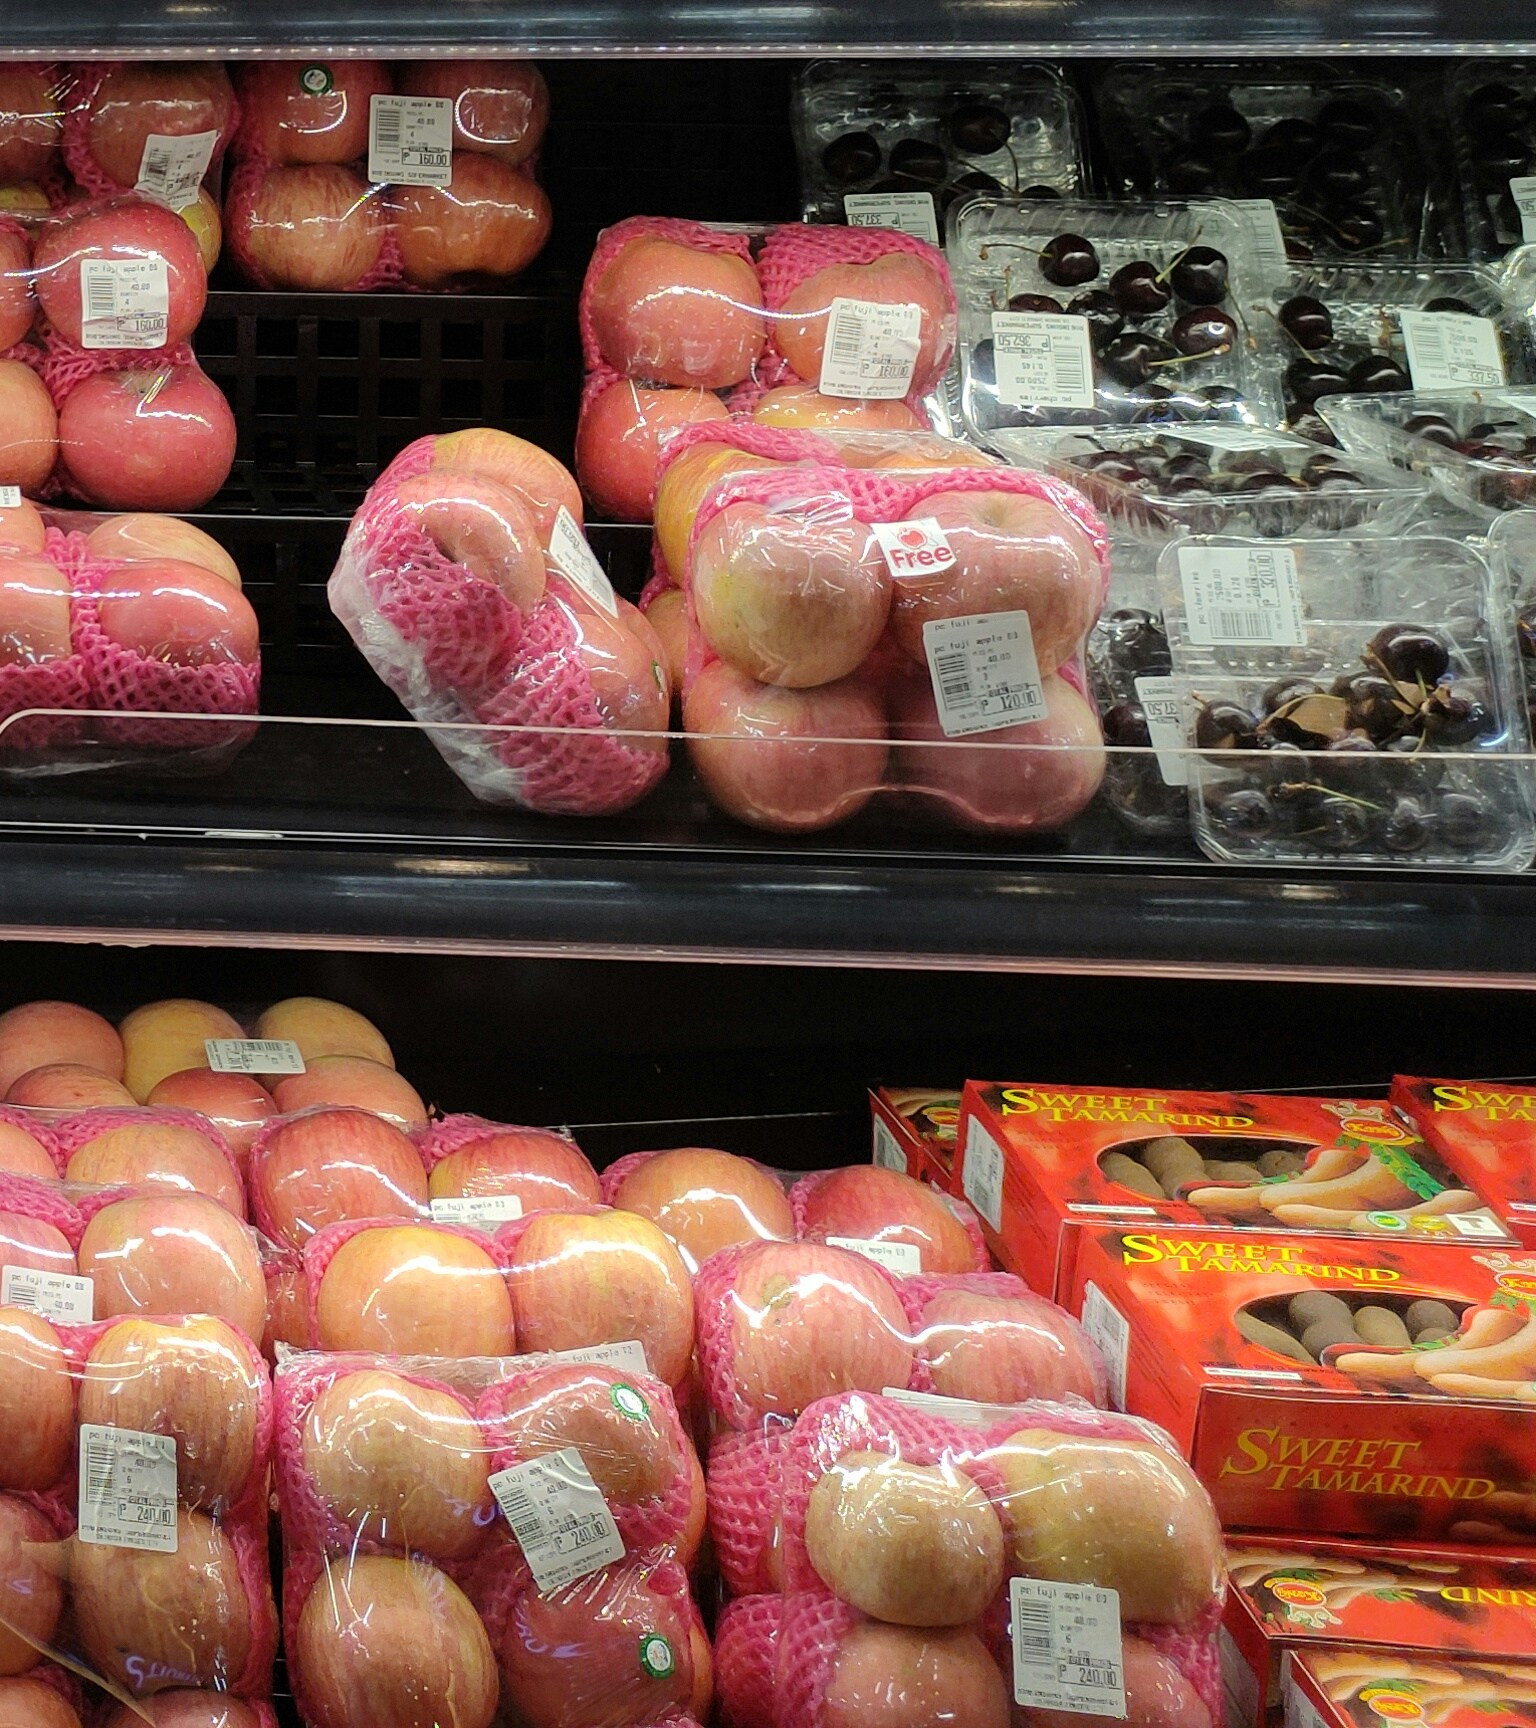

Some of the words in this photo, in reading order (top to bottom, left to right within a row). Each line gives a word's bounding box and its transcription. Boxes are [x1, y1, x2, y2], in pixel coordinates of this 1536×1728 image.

[419, 153, 447, 165] 160.00
[999, 335, 1031, 347] 362.50
[890, 547, 952, 568] Free
